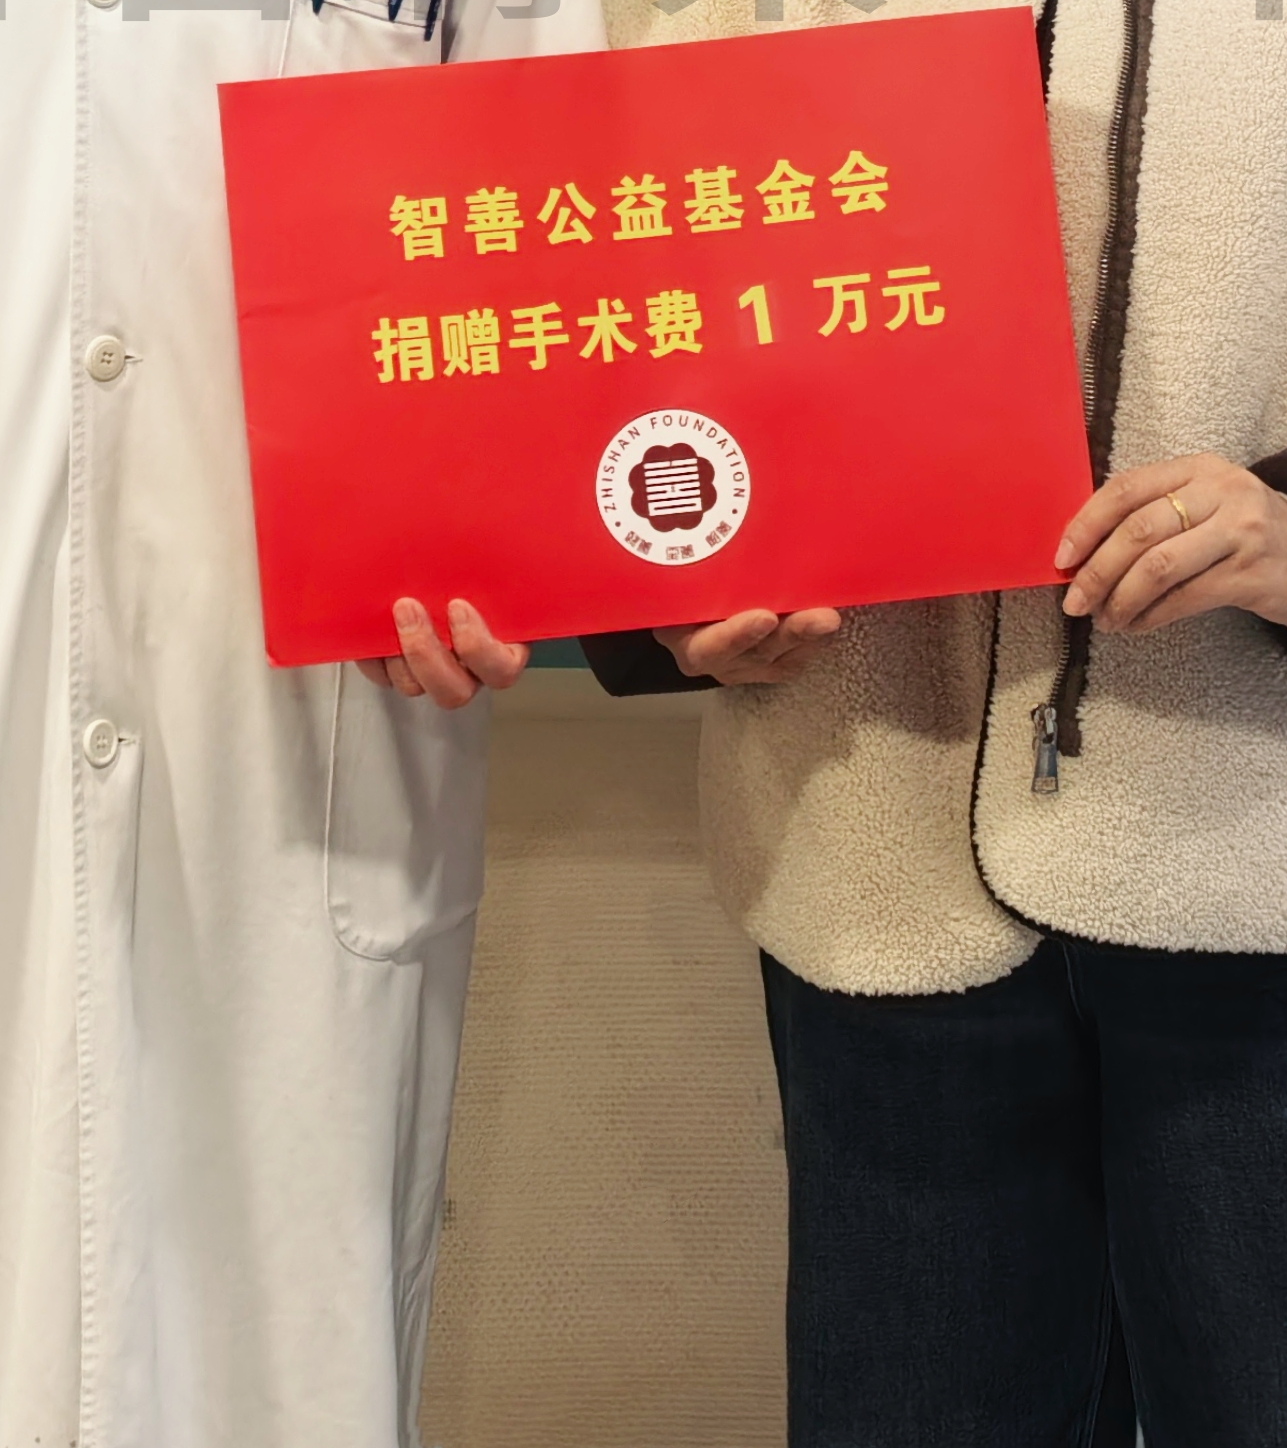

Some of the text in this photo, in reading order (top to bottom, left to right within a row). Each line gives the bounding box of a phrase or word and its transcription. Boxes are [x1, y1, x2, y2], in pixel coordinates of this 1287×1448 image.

[389, 150, 889, 261] 智善公益基金会
[371, 265, 945, 383] 捐赠手术费 1 万元
[601, 414, 746, 513] ZHISHAN FOUNDATION
